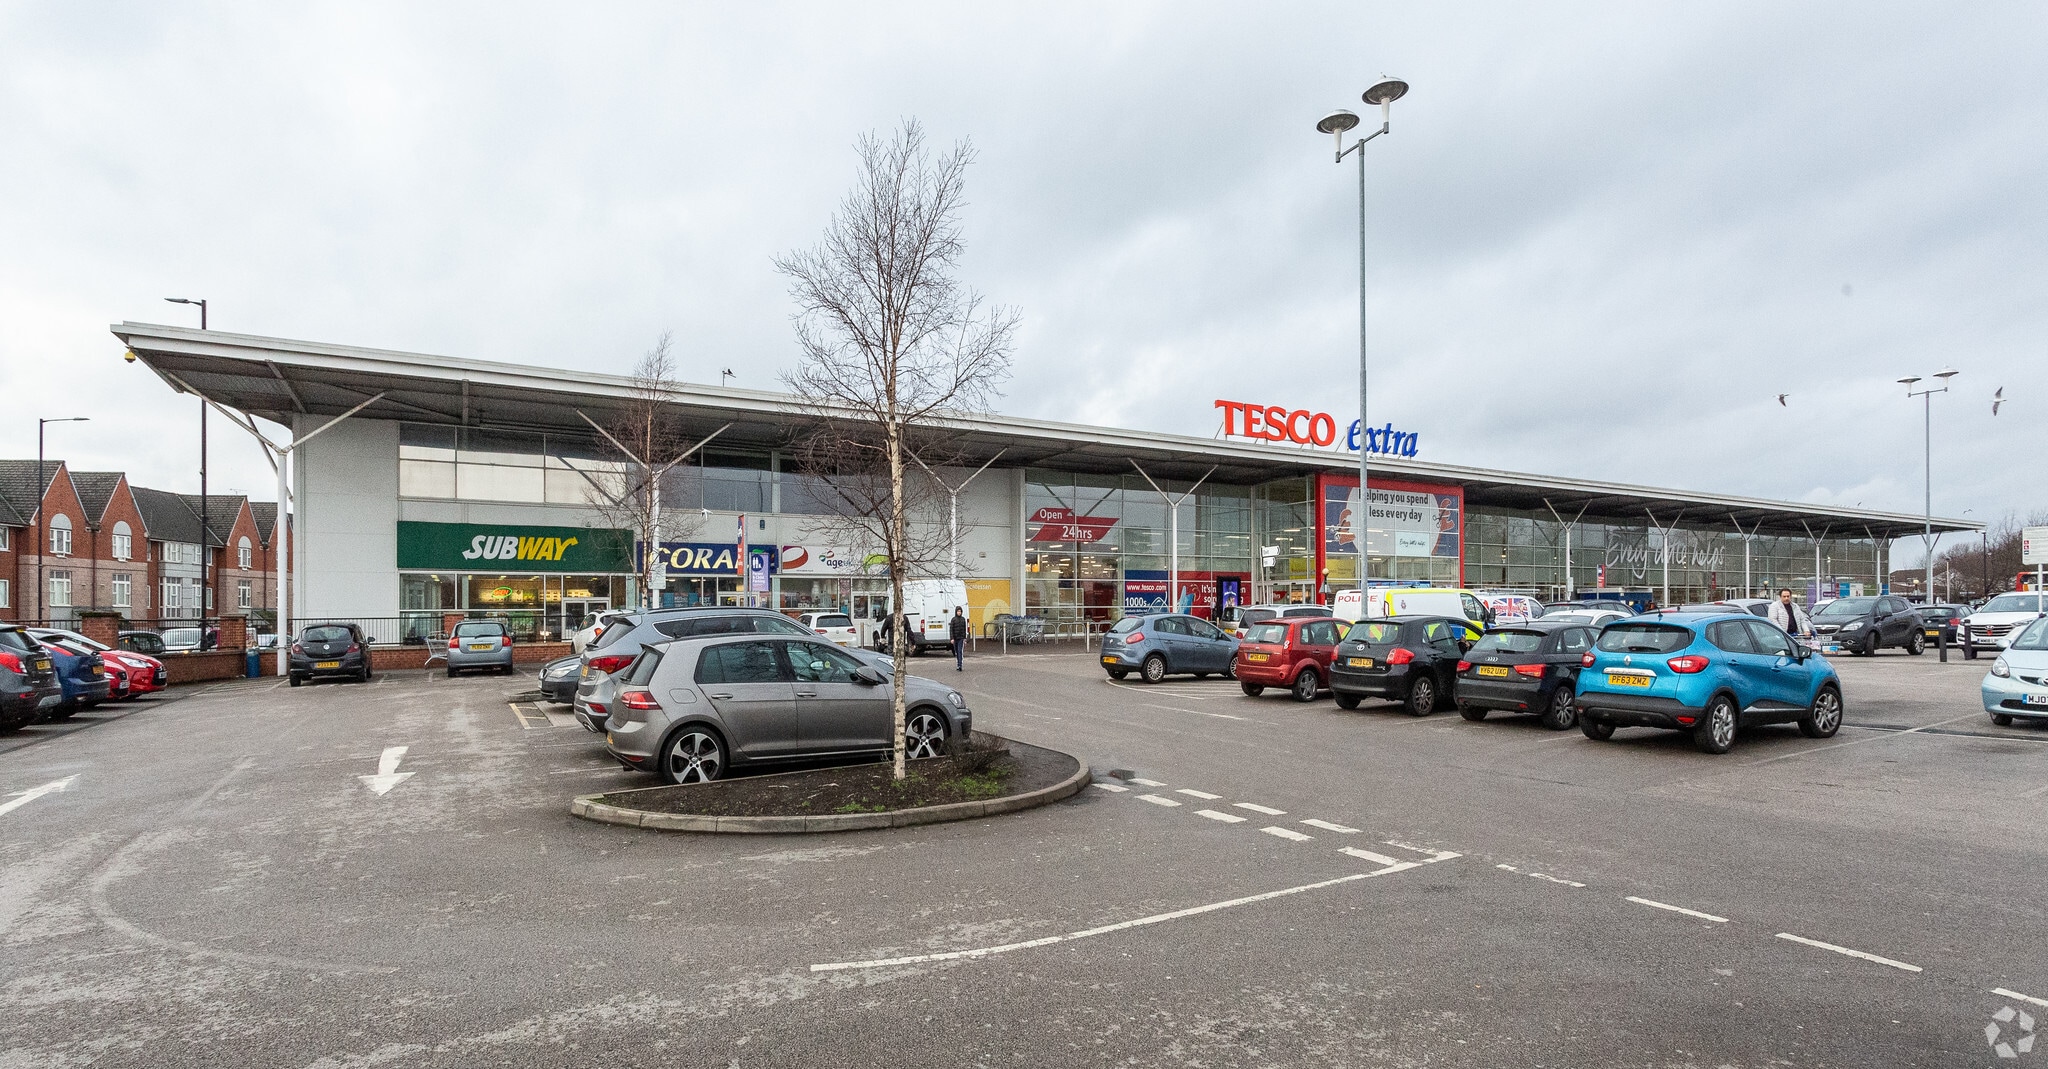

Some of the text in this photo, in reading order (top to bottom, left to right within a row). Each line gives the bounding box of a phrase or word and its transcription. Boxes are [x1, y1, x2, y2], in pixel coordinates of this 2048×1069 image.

[1215, 400, 1419, 457] TESCO extra
[1390, 495, 1405, 504] you
[1407, 494, 1429, 505] spend
[1040, 509, 1062, 520] Open
[1369, 506, 1422, 522] less every day
[462, 535, 579, 561] SUBWAY
[649, 547, 741, 569] CORA
[1606, 533, 1648, 579] Every
[1692, 540, 1725, 572] helps
[827, 559, 843, 569] age
[1337, 595, 1378, 603] POLIE
[1611, 675, 1647, 686] PF63 ZMZ
